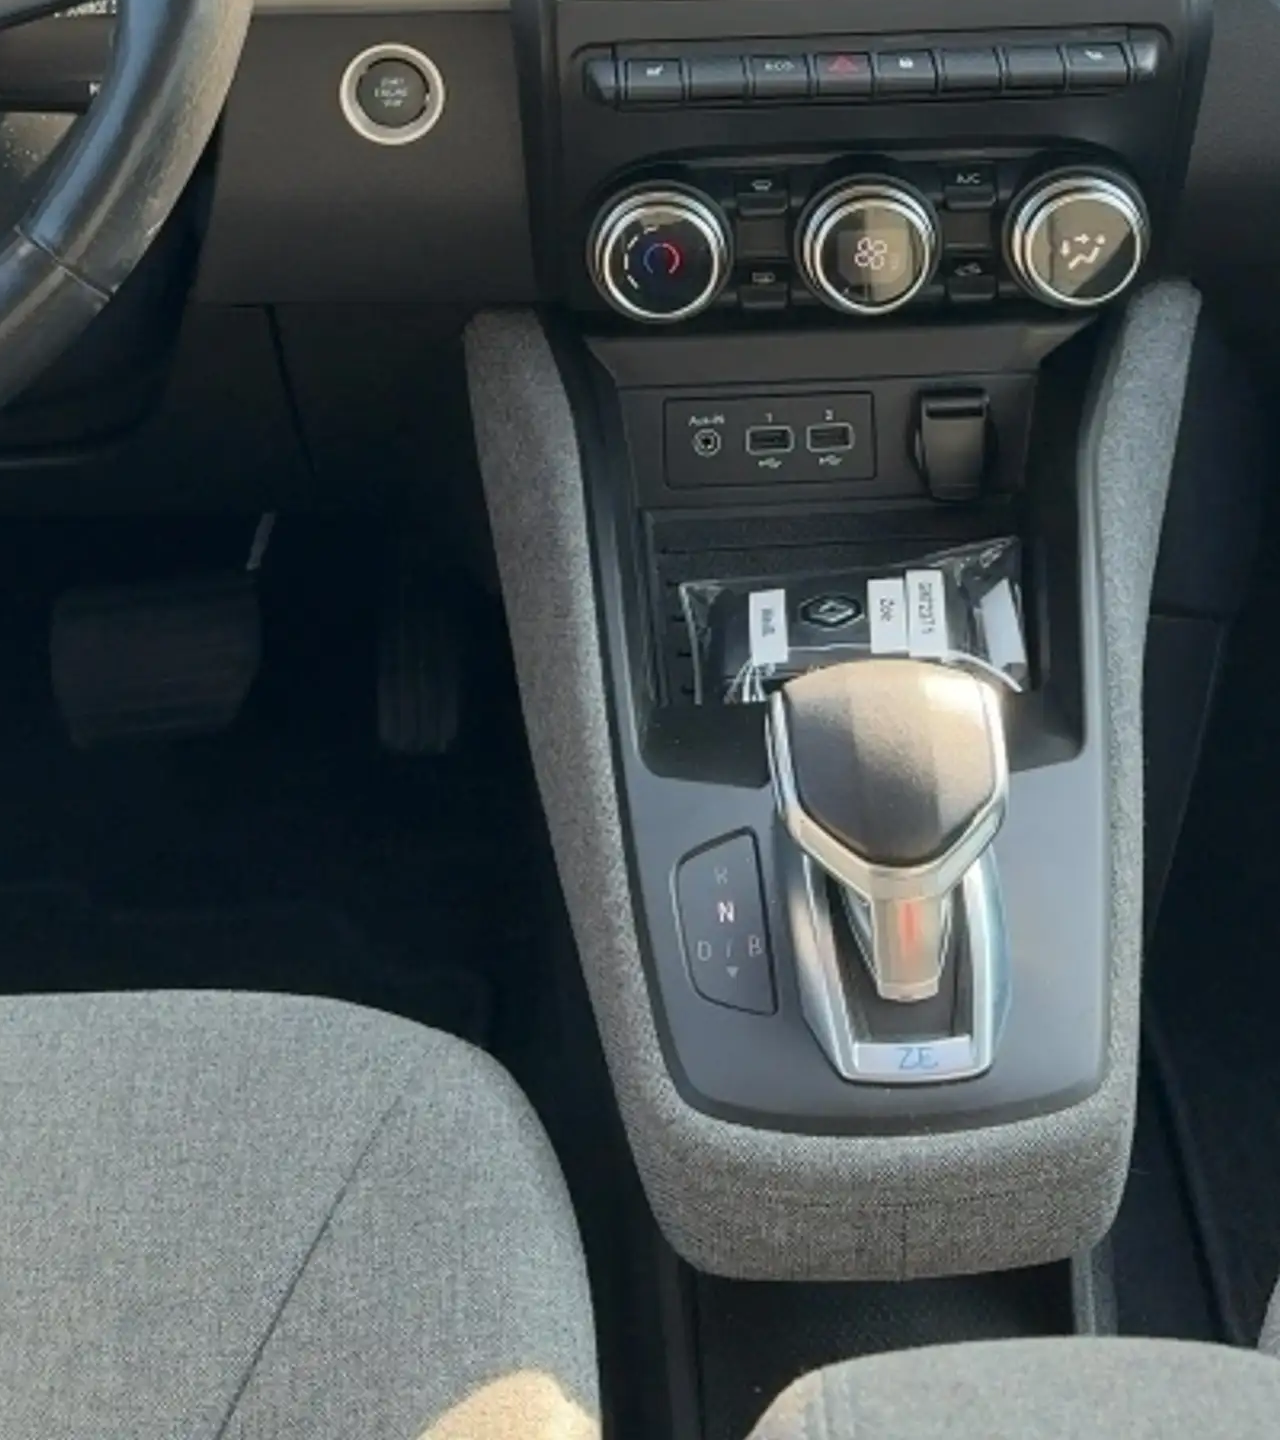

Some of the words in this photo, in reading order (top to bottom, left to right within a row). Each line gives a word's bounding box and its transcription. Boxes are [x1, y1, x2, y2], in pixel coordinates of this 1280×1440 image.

[716, 900, 735, 924] N
[696, 940, 713, 962] D
[747, 933, 764, 958] B
